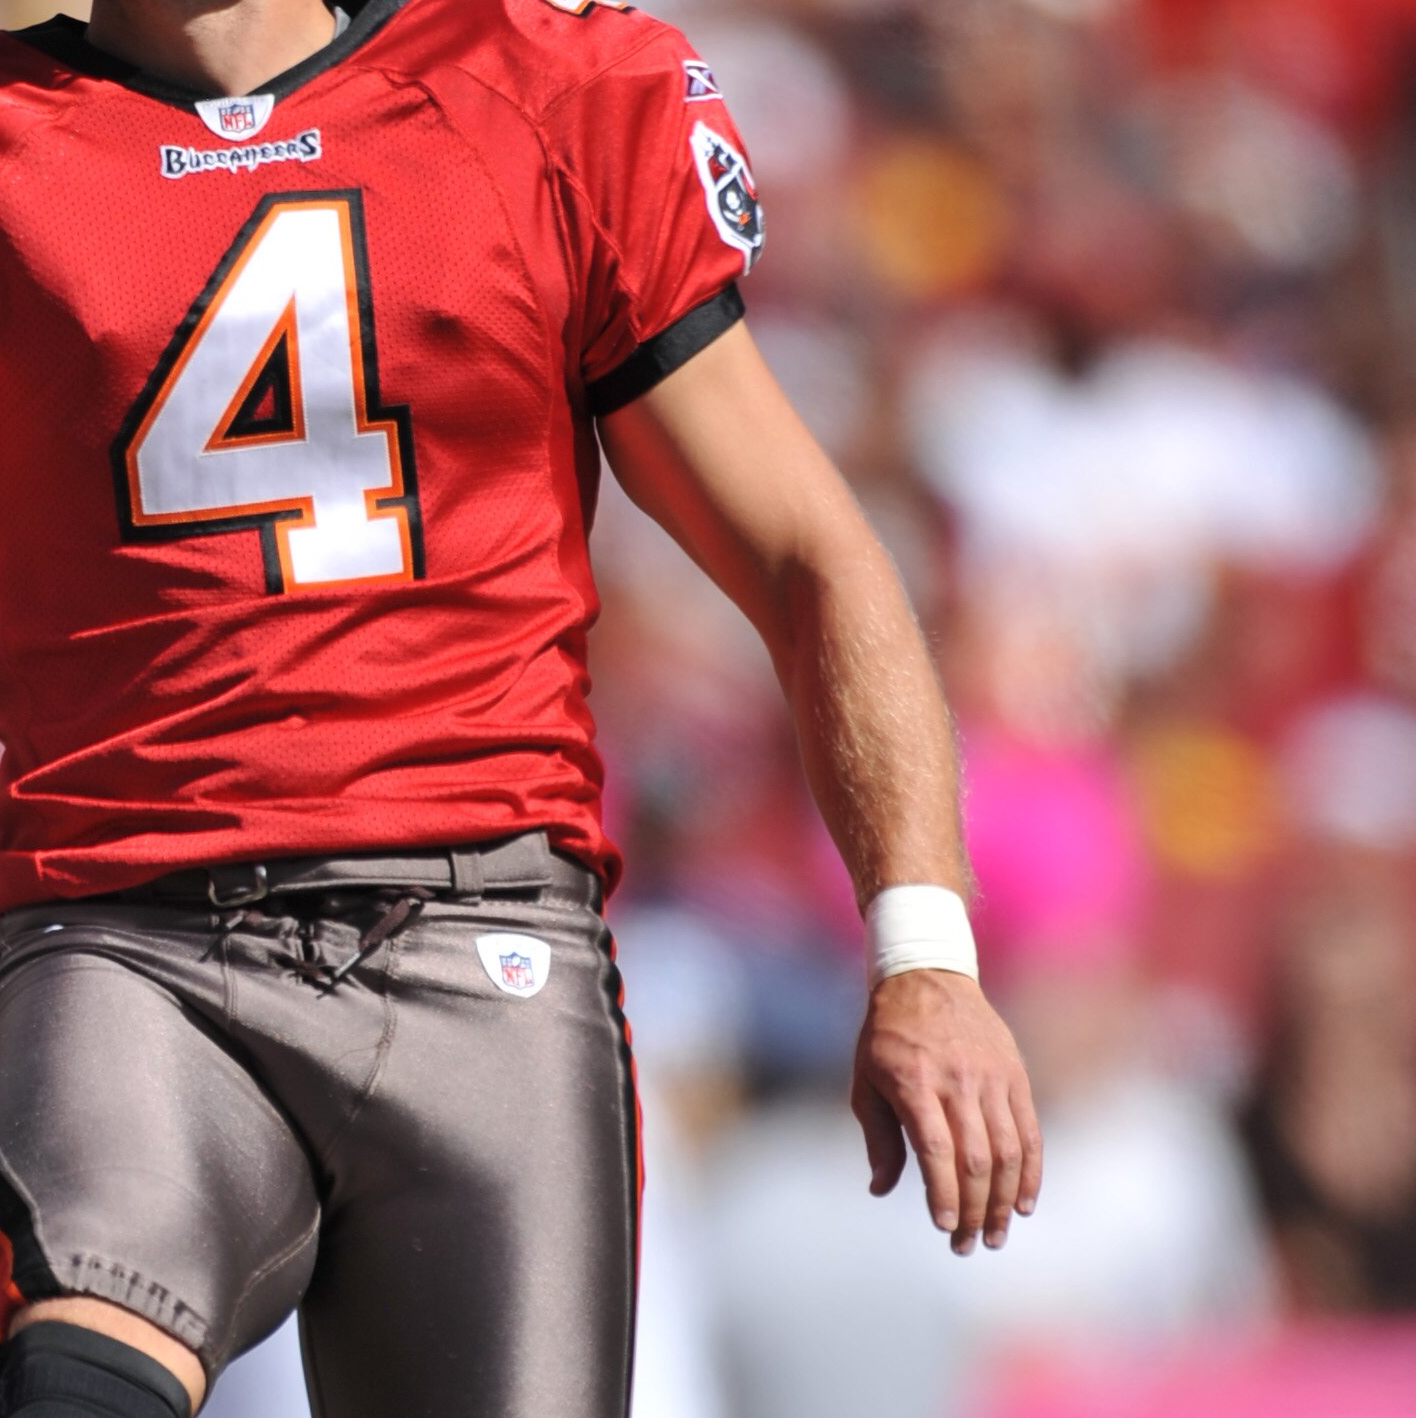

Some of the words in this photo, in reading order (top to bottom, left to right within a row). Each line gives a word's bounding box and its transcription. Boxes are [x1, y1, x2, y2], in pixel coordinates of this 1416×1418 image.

[221, 113, 253, 131] NFL
[117, 193, 419, 592] 4
[503, 967, 533, 987] NFL
